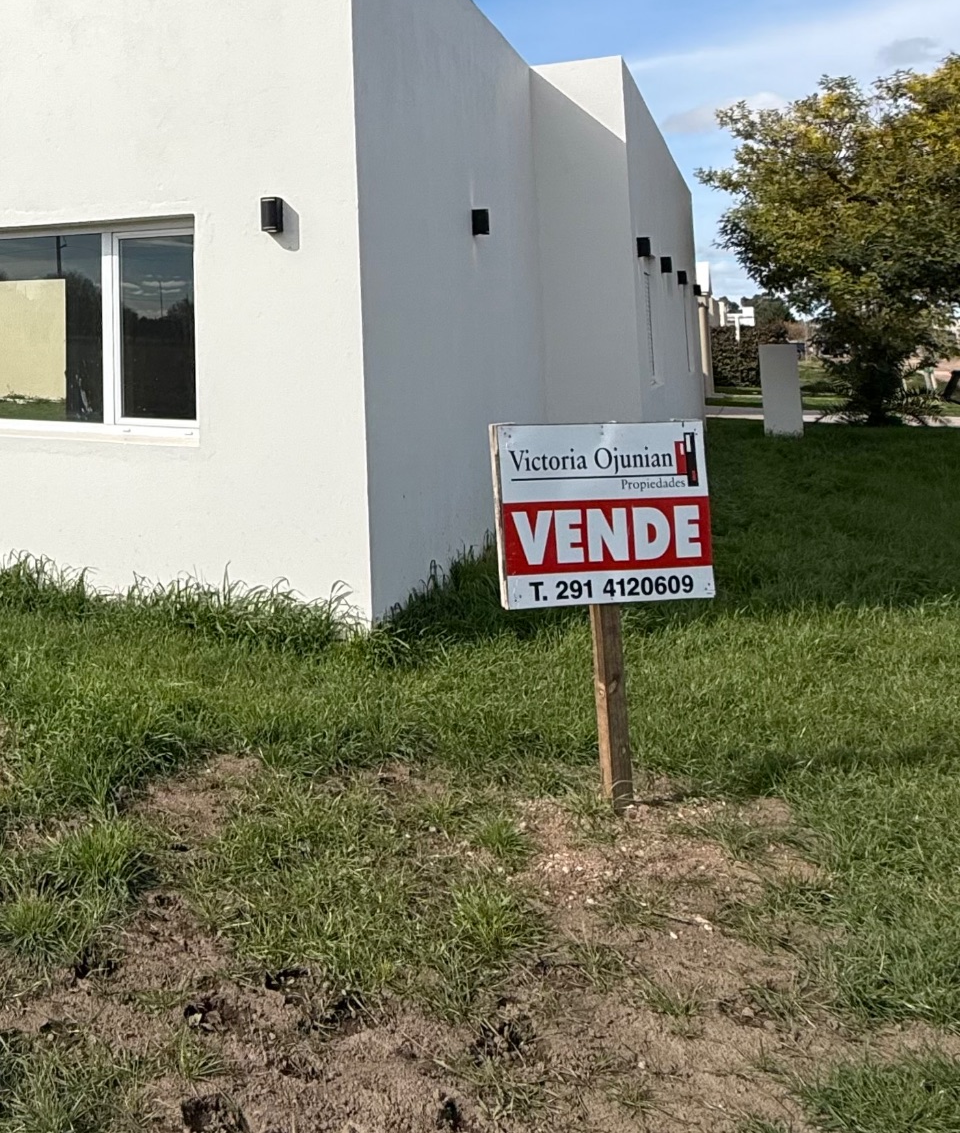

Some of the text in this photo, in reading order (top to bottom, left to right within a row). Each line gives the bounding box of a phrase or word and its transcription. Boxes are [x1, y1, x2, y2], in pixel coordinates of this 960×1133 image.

[509, 446, 674, 474] Victoria Ojunian
[621, 478, 686, 492] Propiedades
[511, 505, 702, 566] VENDE
[529, 574, 694, 602] T. 291 4120609
